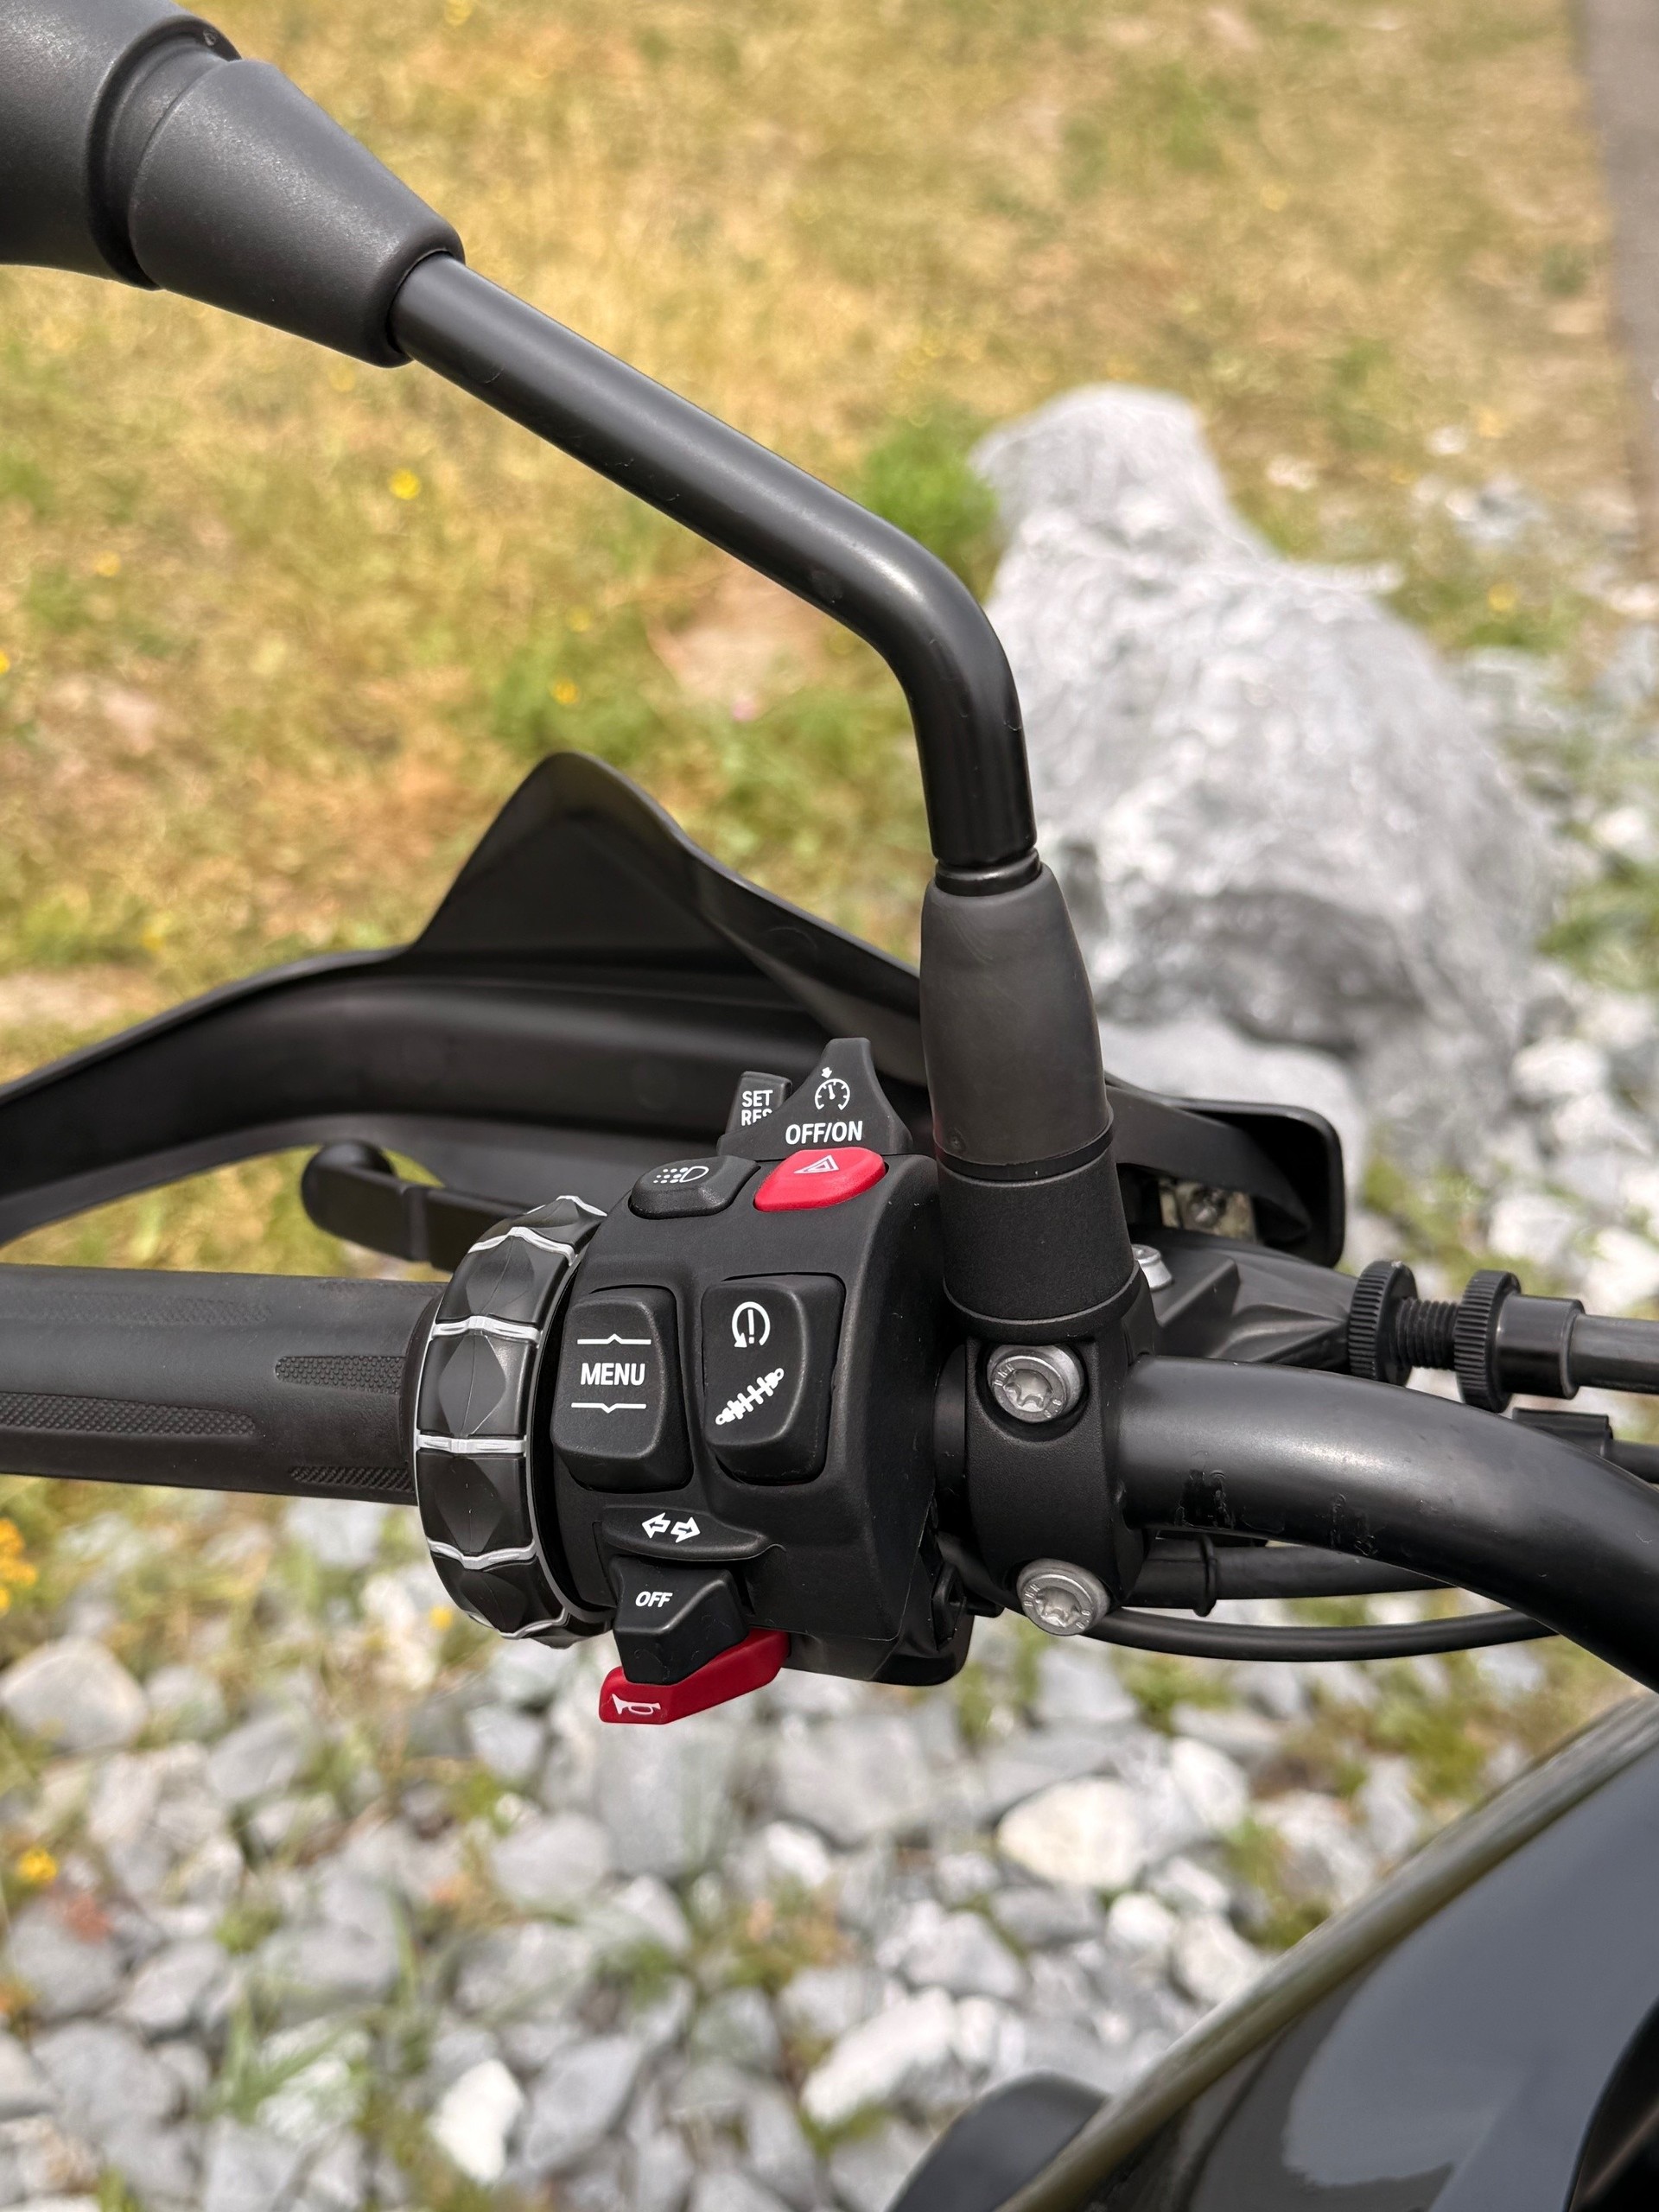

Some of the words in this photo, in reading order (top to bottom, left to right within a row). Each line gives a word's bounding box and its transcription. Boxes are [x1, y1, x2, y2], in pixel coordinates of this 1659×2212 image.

[741, 1090, 773, 1107] SET
[785, 1121, 862, 1145] OFF/ON
[581, 1363, 645, 1385] MENU
[635, 1592, 673, 1607] OFF
